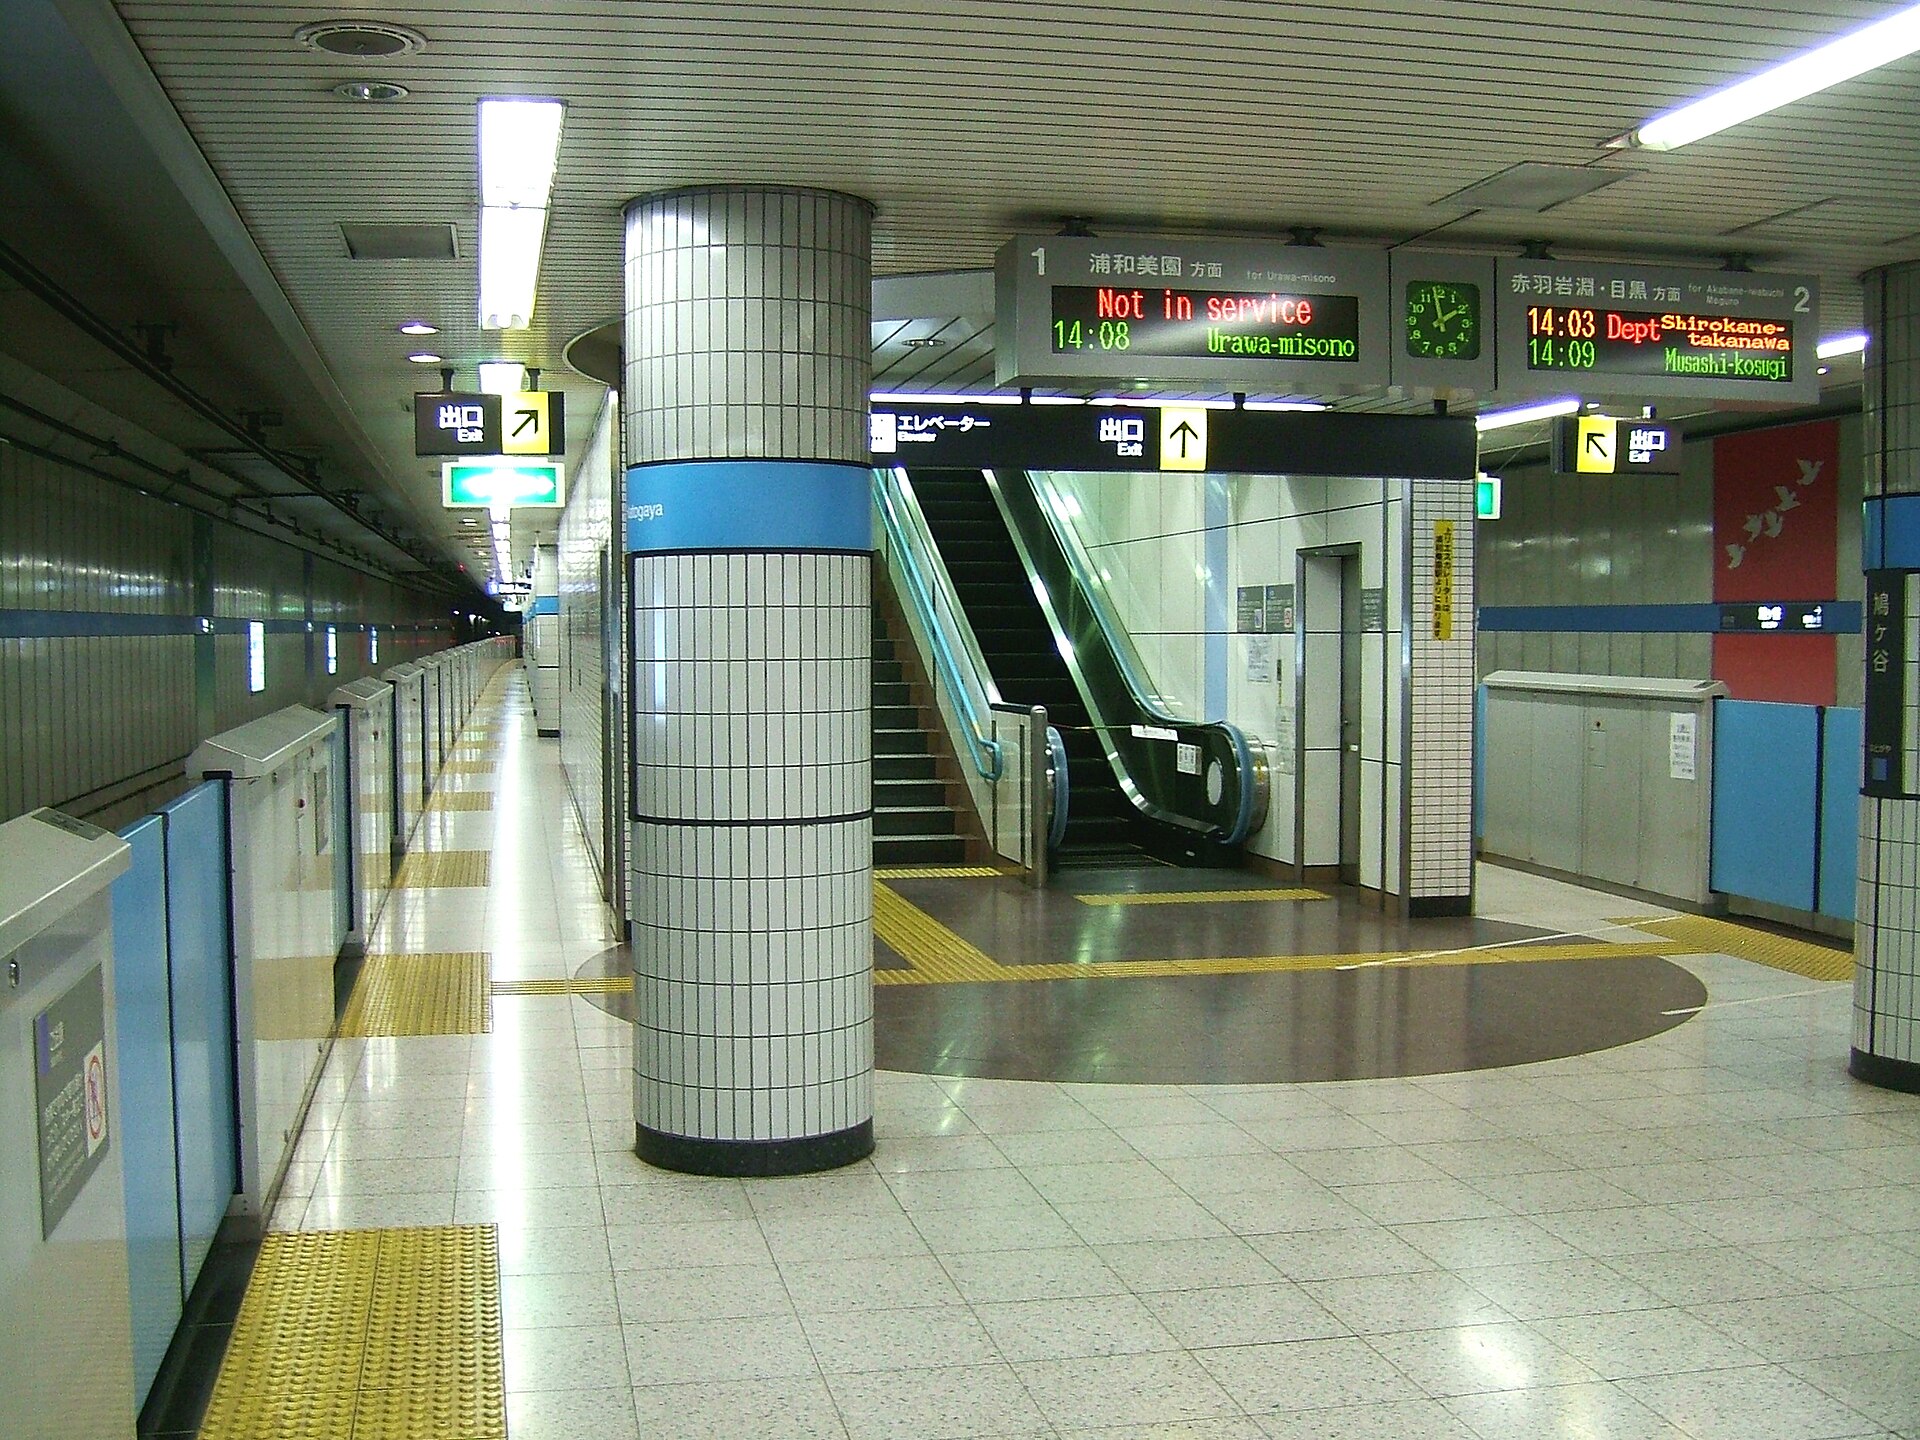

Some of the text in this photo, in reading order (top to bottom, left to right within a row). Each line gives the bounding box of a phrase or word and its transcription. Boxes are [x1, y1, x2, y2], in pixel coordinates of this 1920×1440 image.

[1031, 248, 1047, 276] 1
[1088, 253, 1223, 278] 浦和美園 方面
[1097, 288, 1312, 325] Not in service
[1653, 286, 1681, 302] 方面
[1793, 286, 1811, 313] 2
[1054, 321, 1131, 351] 14:08
[1528, 307, 1786, 343] 14:03 Dept Shirokane-
[1207, 328, 1355, 358] Urawa-misono
[1528, 338, 1596, 368] 14:09
[1687, 332, 1790, 351] takanawa
[1664, 349, 1787, 380] Musashi-kosugi
[438, 404, 484, 430] 出口
[897, 414, 991, 433] エレベーター
[1099, 417, 1144, 443] 出口
[1628, 429, 1665, 452] 出口
